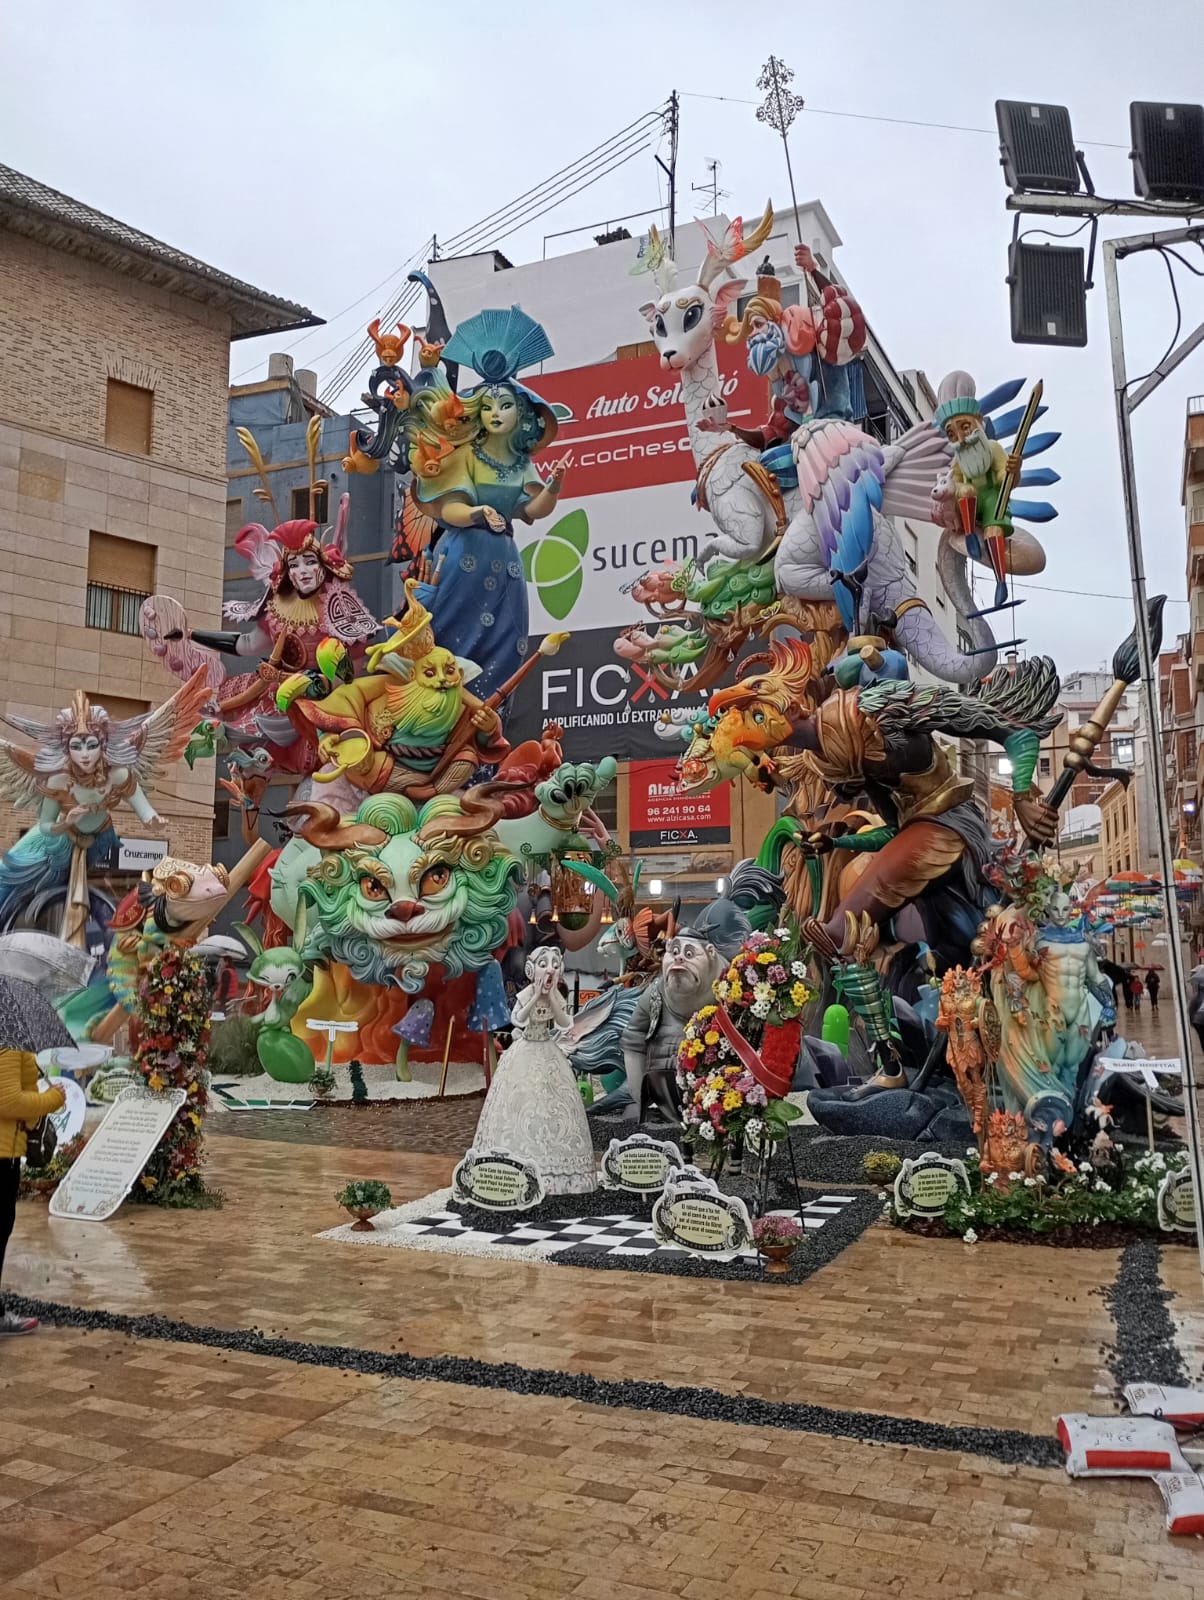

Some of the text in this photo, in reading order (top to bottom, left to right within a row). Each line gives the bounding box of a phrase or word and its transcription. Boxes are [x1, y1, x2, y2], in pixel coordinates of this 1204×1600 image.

[586, 391, 640, 420] Auto
[541, 712, 614, 730] AMPLIFICANDO
[616, 711, 630, 724] LO
[647, 804, 711, 816] 96 241 90 64
[647, 814, 712, 823] www.alzicasa.com
[124, 849, 164, 861] Cruzcampo
